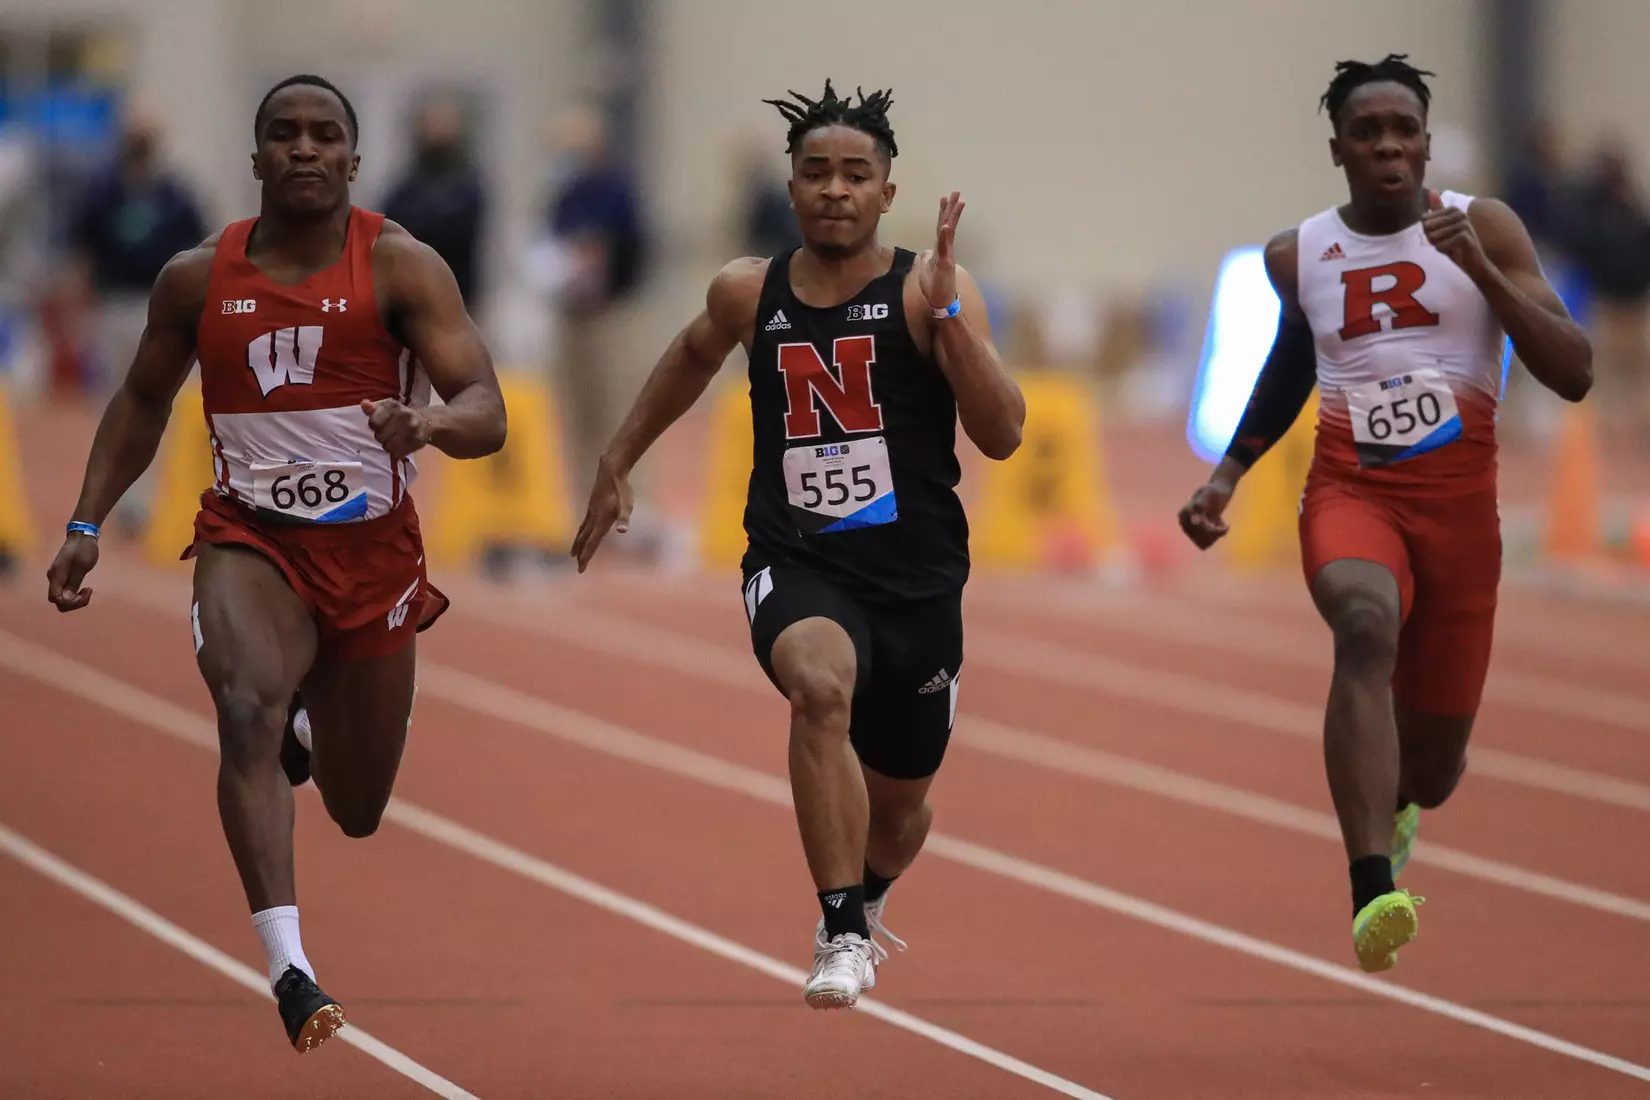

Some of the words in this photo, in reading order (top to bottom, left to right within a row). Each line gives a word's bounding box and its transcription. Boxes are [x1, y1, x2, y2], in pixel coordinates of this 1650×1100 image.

[1338, 261, 1439, 341] R
[765, 322, 792, 332] adidas
[248, 325, 324, 398] W
[777, 334, 884, 440] N
[1367, 392, 1441, 440] 650
[271, 469, 349, 510] 668
[800, 464, 877, 509] 555
